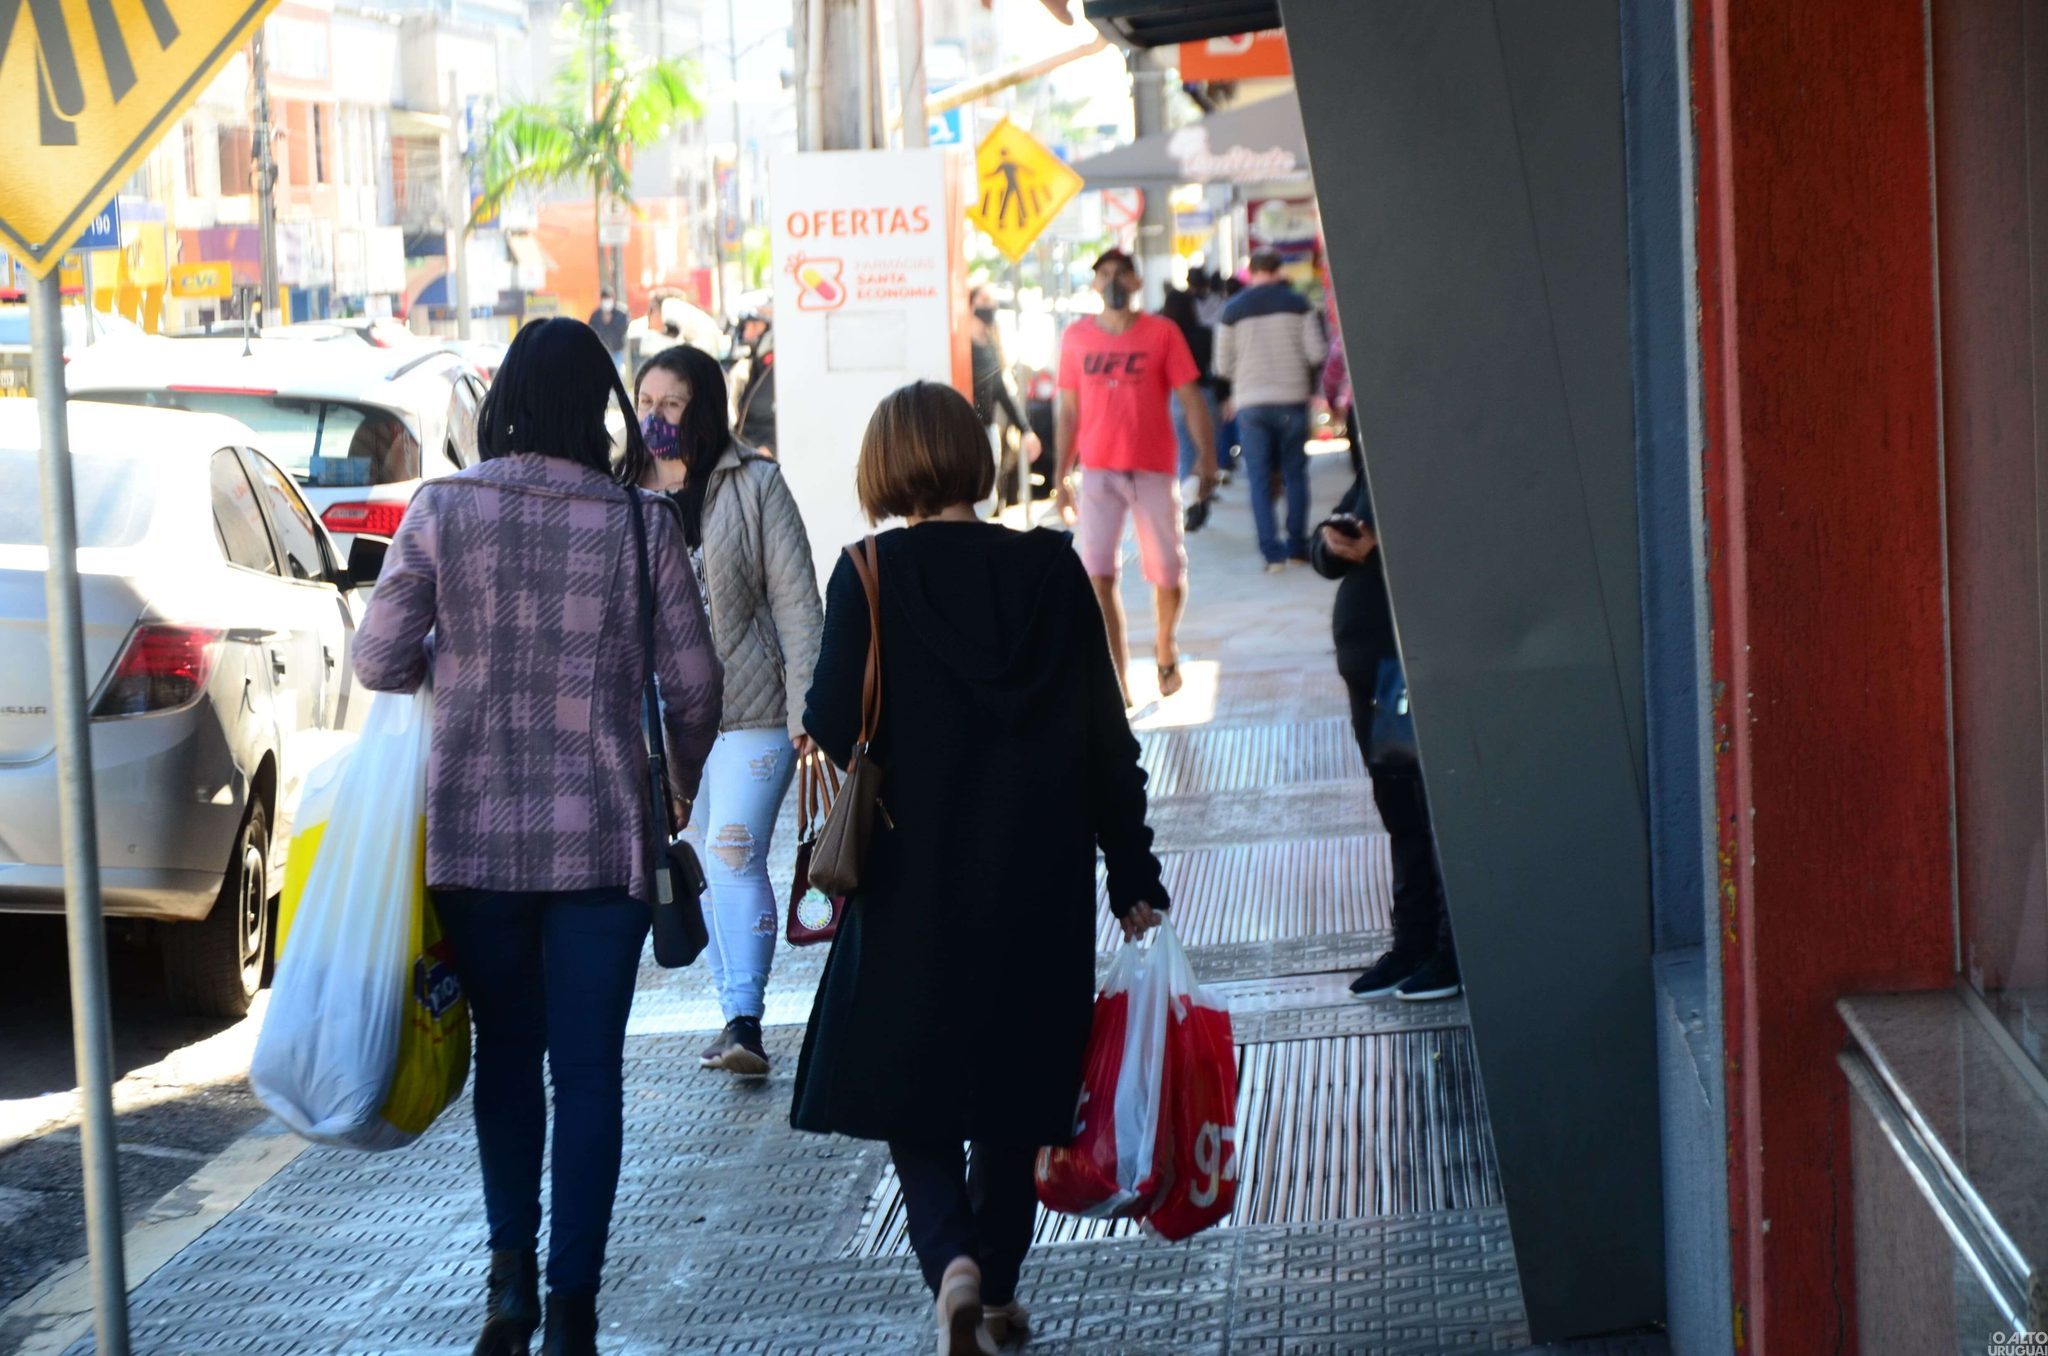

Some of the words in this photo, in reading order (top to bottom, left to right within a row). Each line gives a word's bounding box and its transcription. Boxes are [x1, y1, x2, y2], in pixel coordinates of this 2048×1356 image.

[786, 205, 930, 239] OFERTAS
[857, 273, 907, 286] SANTA
[857, 286, 938, 301] ECONOMIA
[1084, 352, 1148, 376] UFC
